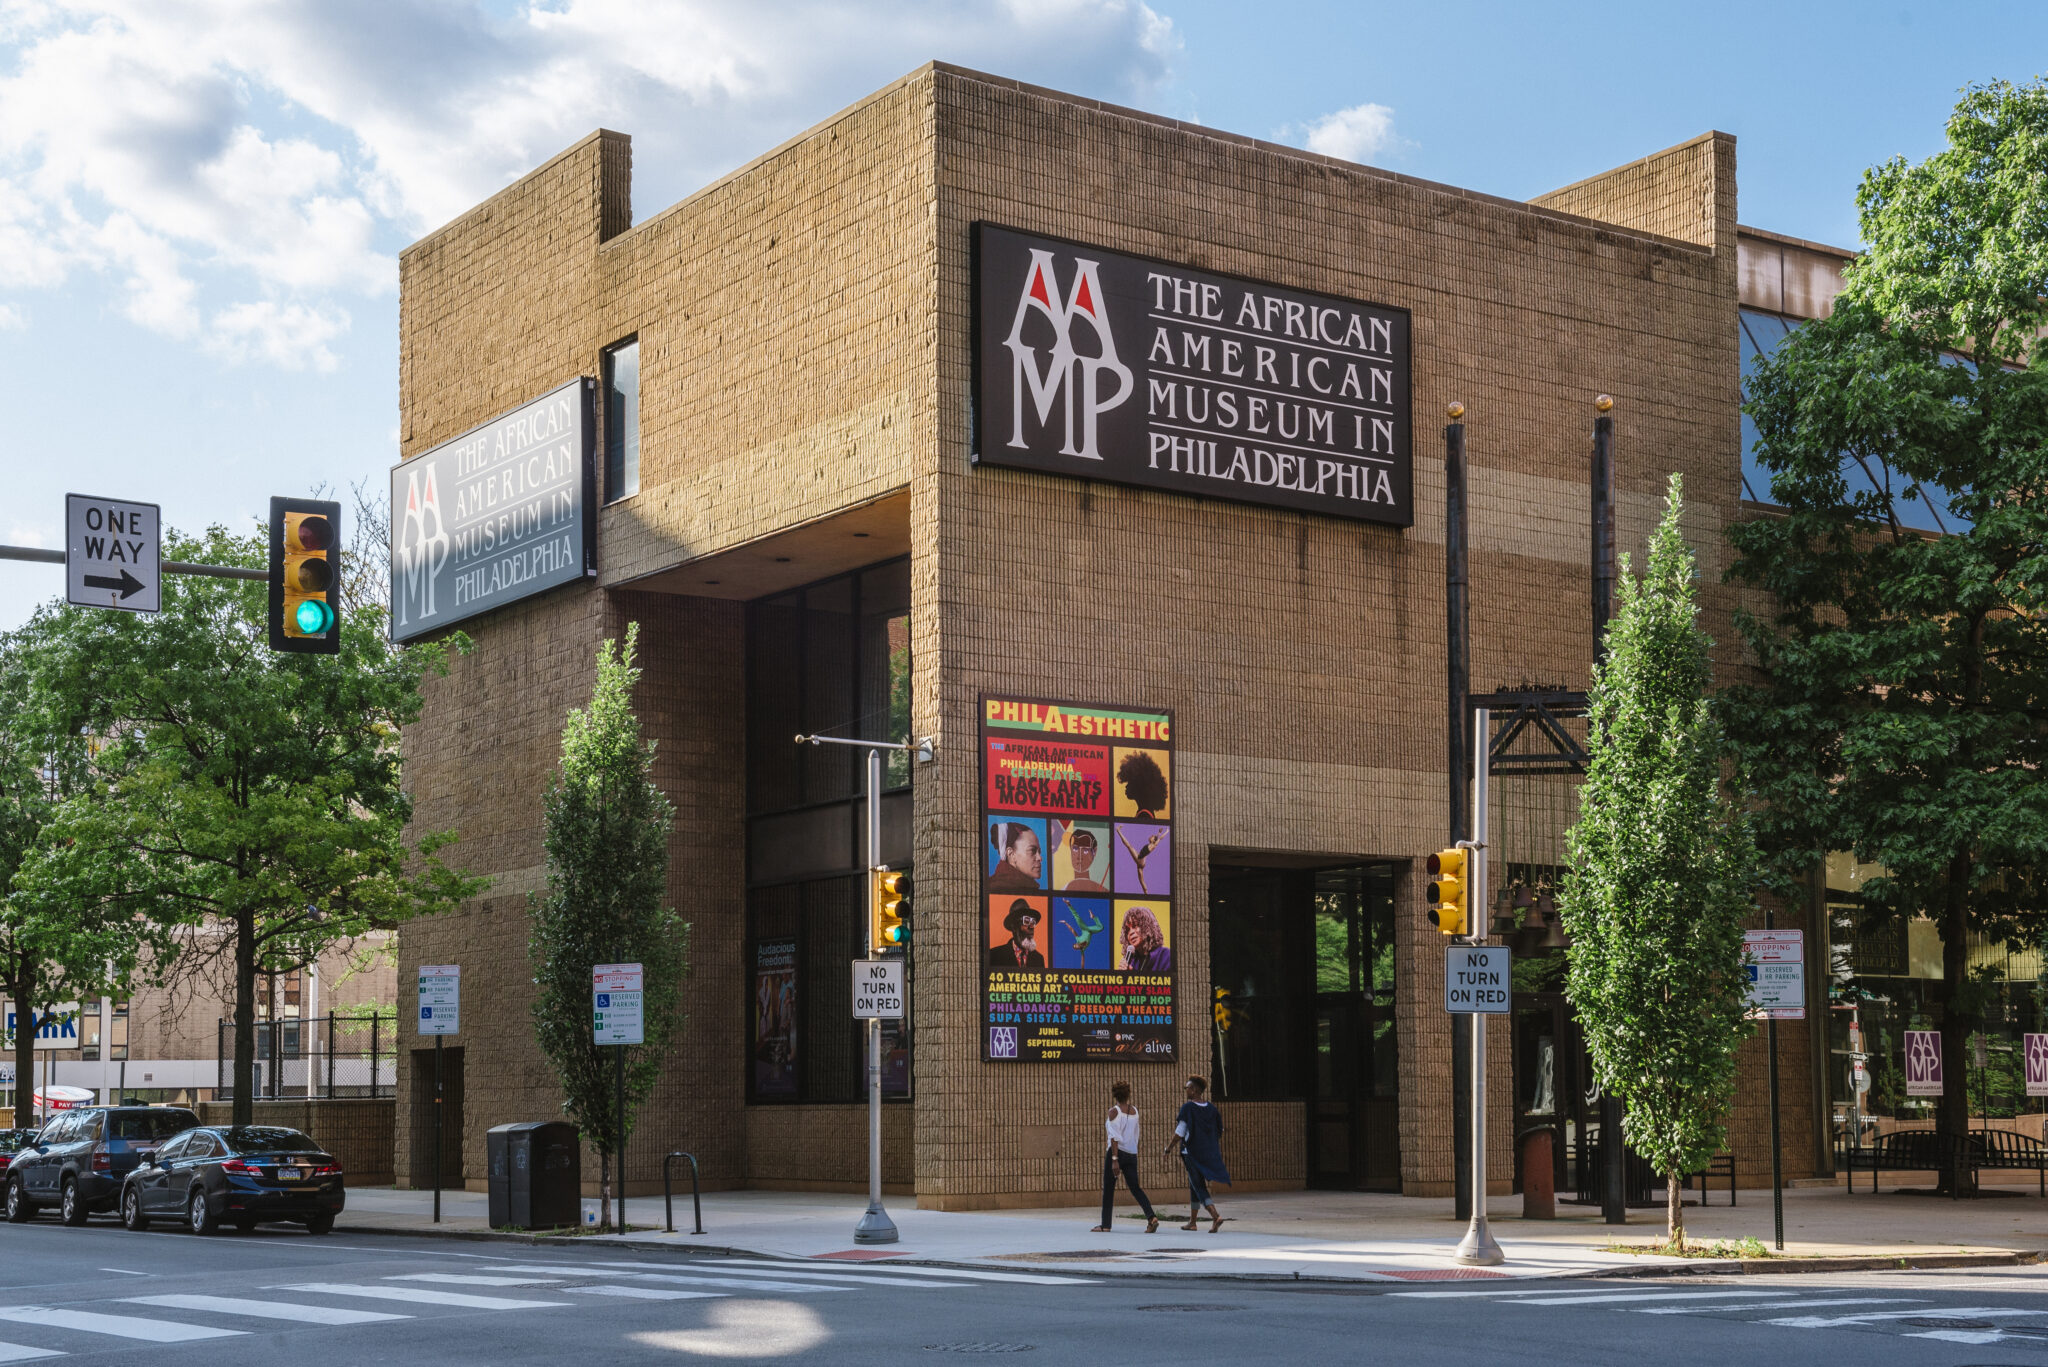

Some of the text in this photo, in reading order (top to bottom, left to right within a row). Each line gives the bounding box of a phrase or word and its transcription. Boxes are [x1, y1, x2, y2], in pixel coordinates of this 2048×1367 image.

[1148, 272, 1392, 354] THE AFRICAN
[1148, 327, 1392, 404] AMERICAN
[1148, 378, 1394, 454] MUSEUM IN
[455, 396, 572, 478] THE AFRICAN
[1148, 432, 1396, 506] PHILADELPHIA
[454, 442, 573, 521] AMERICAN
[86, 508, 142, 536] ONE
[454, 487, 574, 564] MUSEUM IN
[84, 536, 145, 564] WAY
[455, 535, 574, 606] PHILADELPHIA
[1004, 743, 1048, 756] AFRICAN
[1052, 748, 1104, 760] AMERICAN
[1022, 752, 1066, 763] MUSEUM
[1000, 758, 1074, 772] PHILADELPHIA
[1010, 768, 1082, 782] CELEBRATES
[995, 774, 1102, 798] BLACK ARTS
[1000, 788, 1098, 810] MOVEMENT
[758, 942, 795, 955] Audacious
[1468, 954, 1488, 967] NO
[870, 967, 886, 978] NO
[989, 972, 1171, 986] 40 YEARS OF COLLECTING AFRICAN
[1458, 972, 1499, 985] TURN
[862, 983, 895, 994] TURN
[989, 983, 1171, 995] AMERICAN ART YOUTH POETRY SLAM
[989, 993, 1171, 1005] CLEF CLUB JAZZ, FUNK AND HIP HOP
[1450, 990, 1506, 1002] ON RED
[858, 998, 900, 1009] ON RED
[989, 1003, 1172, 1015] PHILADANCO FREEDOM THEATRE
[989, 1013, 1172, 1025] SUPA SISTAS POETRY READING
[1027, 1039, 1075, 1048] SEPTEMBER,
[1146, 1040, 1171, 1053] alive
